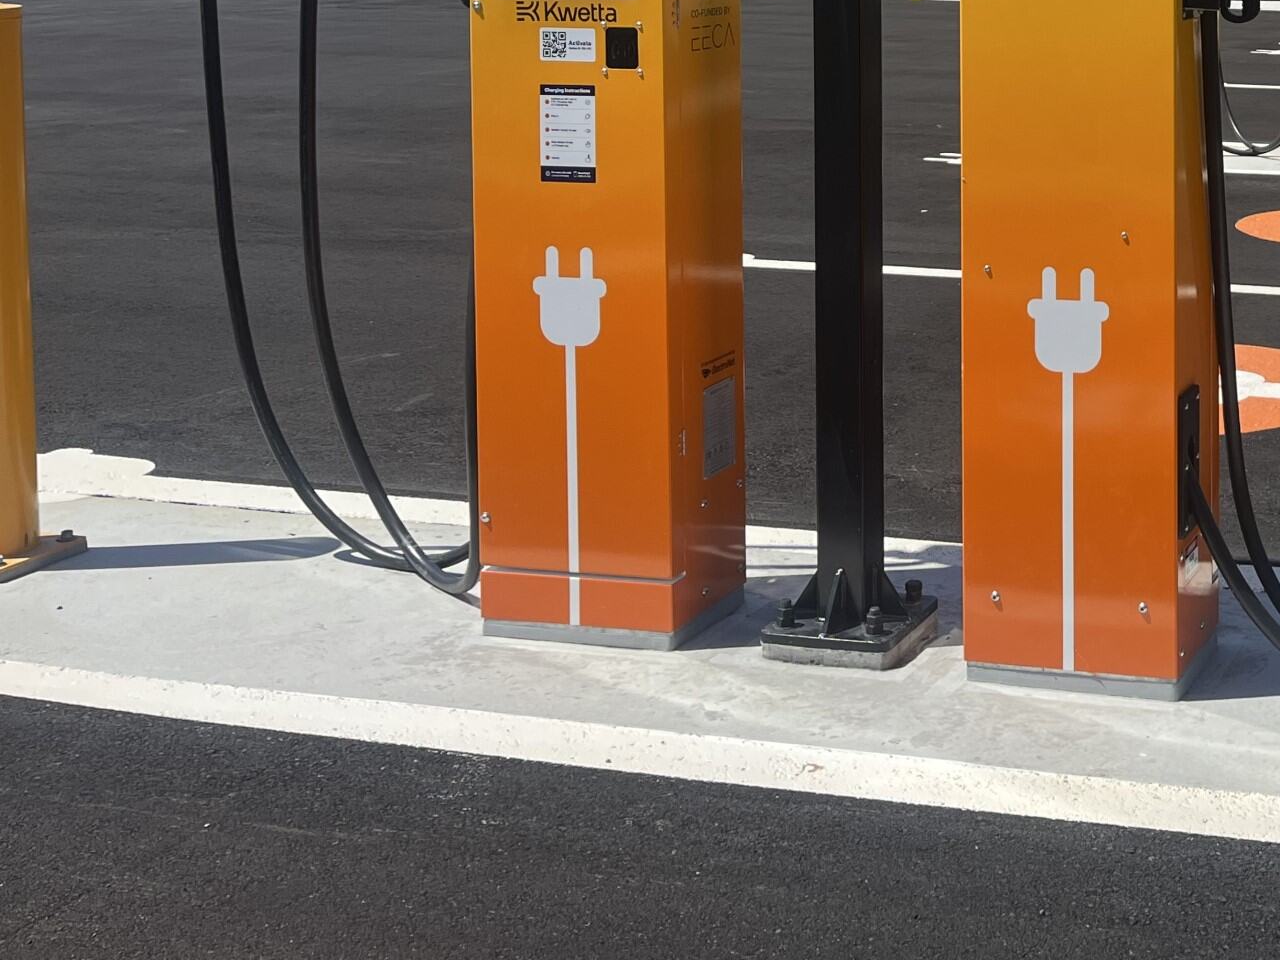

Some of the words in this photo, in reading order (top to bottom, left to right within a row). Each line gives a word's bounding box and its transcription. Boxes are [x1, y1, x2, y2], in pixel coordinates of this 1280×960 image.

[544, 0, 617, 23] Kwetta
[691, 6, 723, 18] CO-FUNDED
[691, 22, 736, 52] EECA
